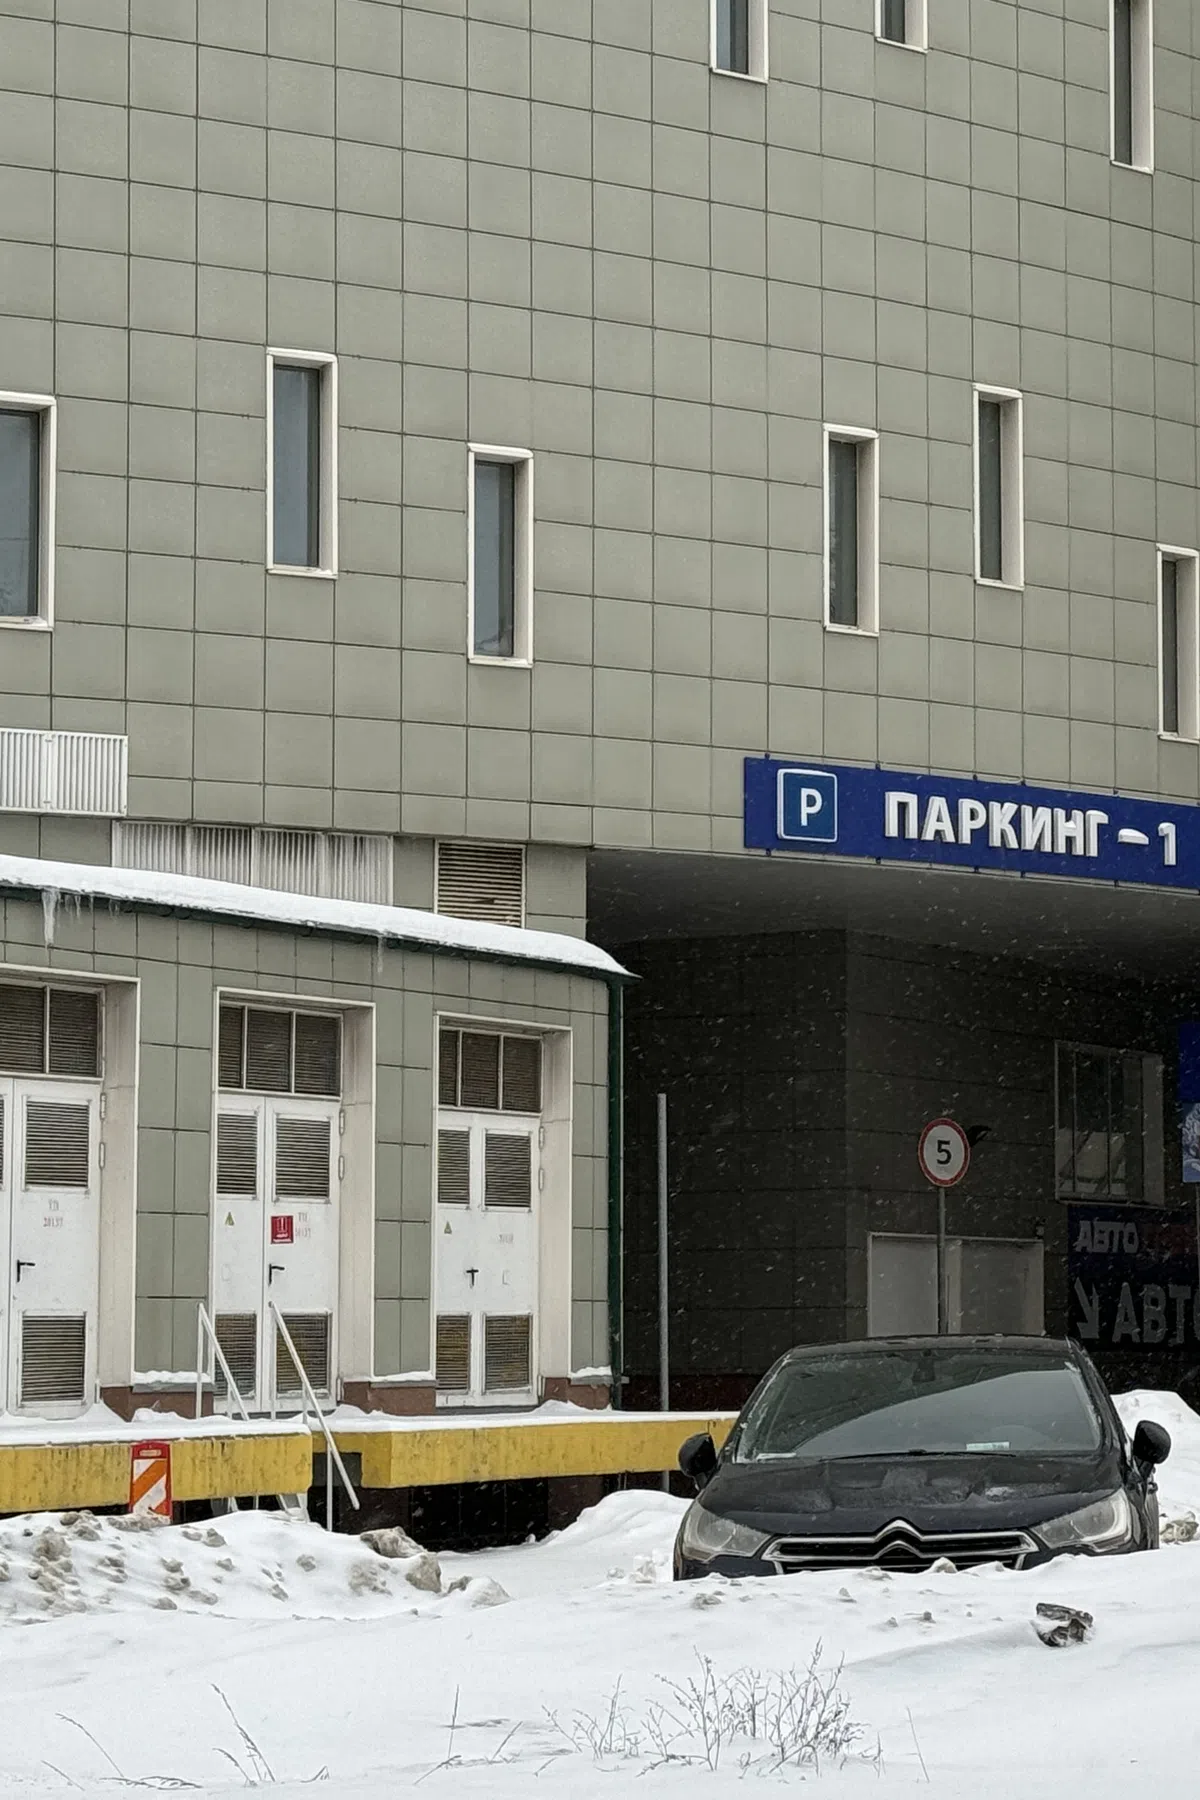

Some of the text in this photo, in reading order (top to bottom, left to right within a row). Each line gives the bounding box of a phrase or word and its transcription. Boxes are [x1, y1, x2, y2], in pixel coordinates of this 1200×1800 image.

[800, 788, 822, 826] P
[884, 791, 1109, 857] ПАРКИНГ
[1158, 821, 1177, 866] 1
[936, 1140, 952, 1165] 5
[1074, 1219, 1140, 1252] АВТО
